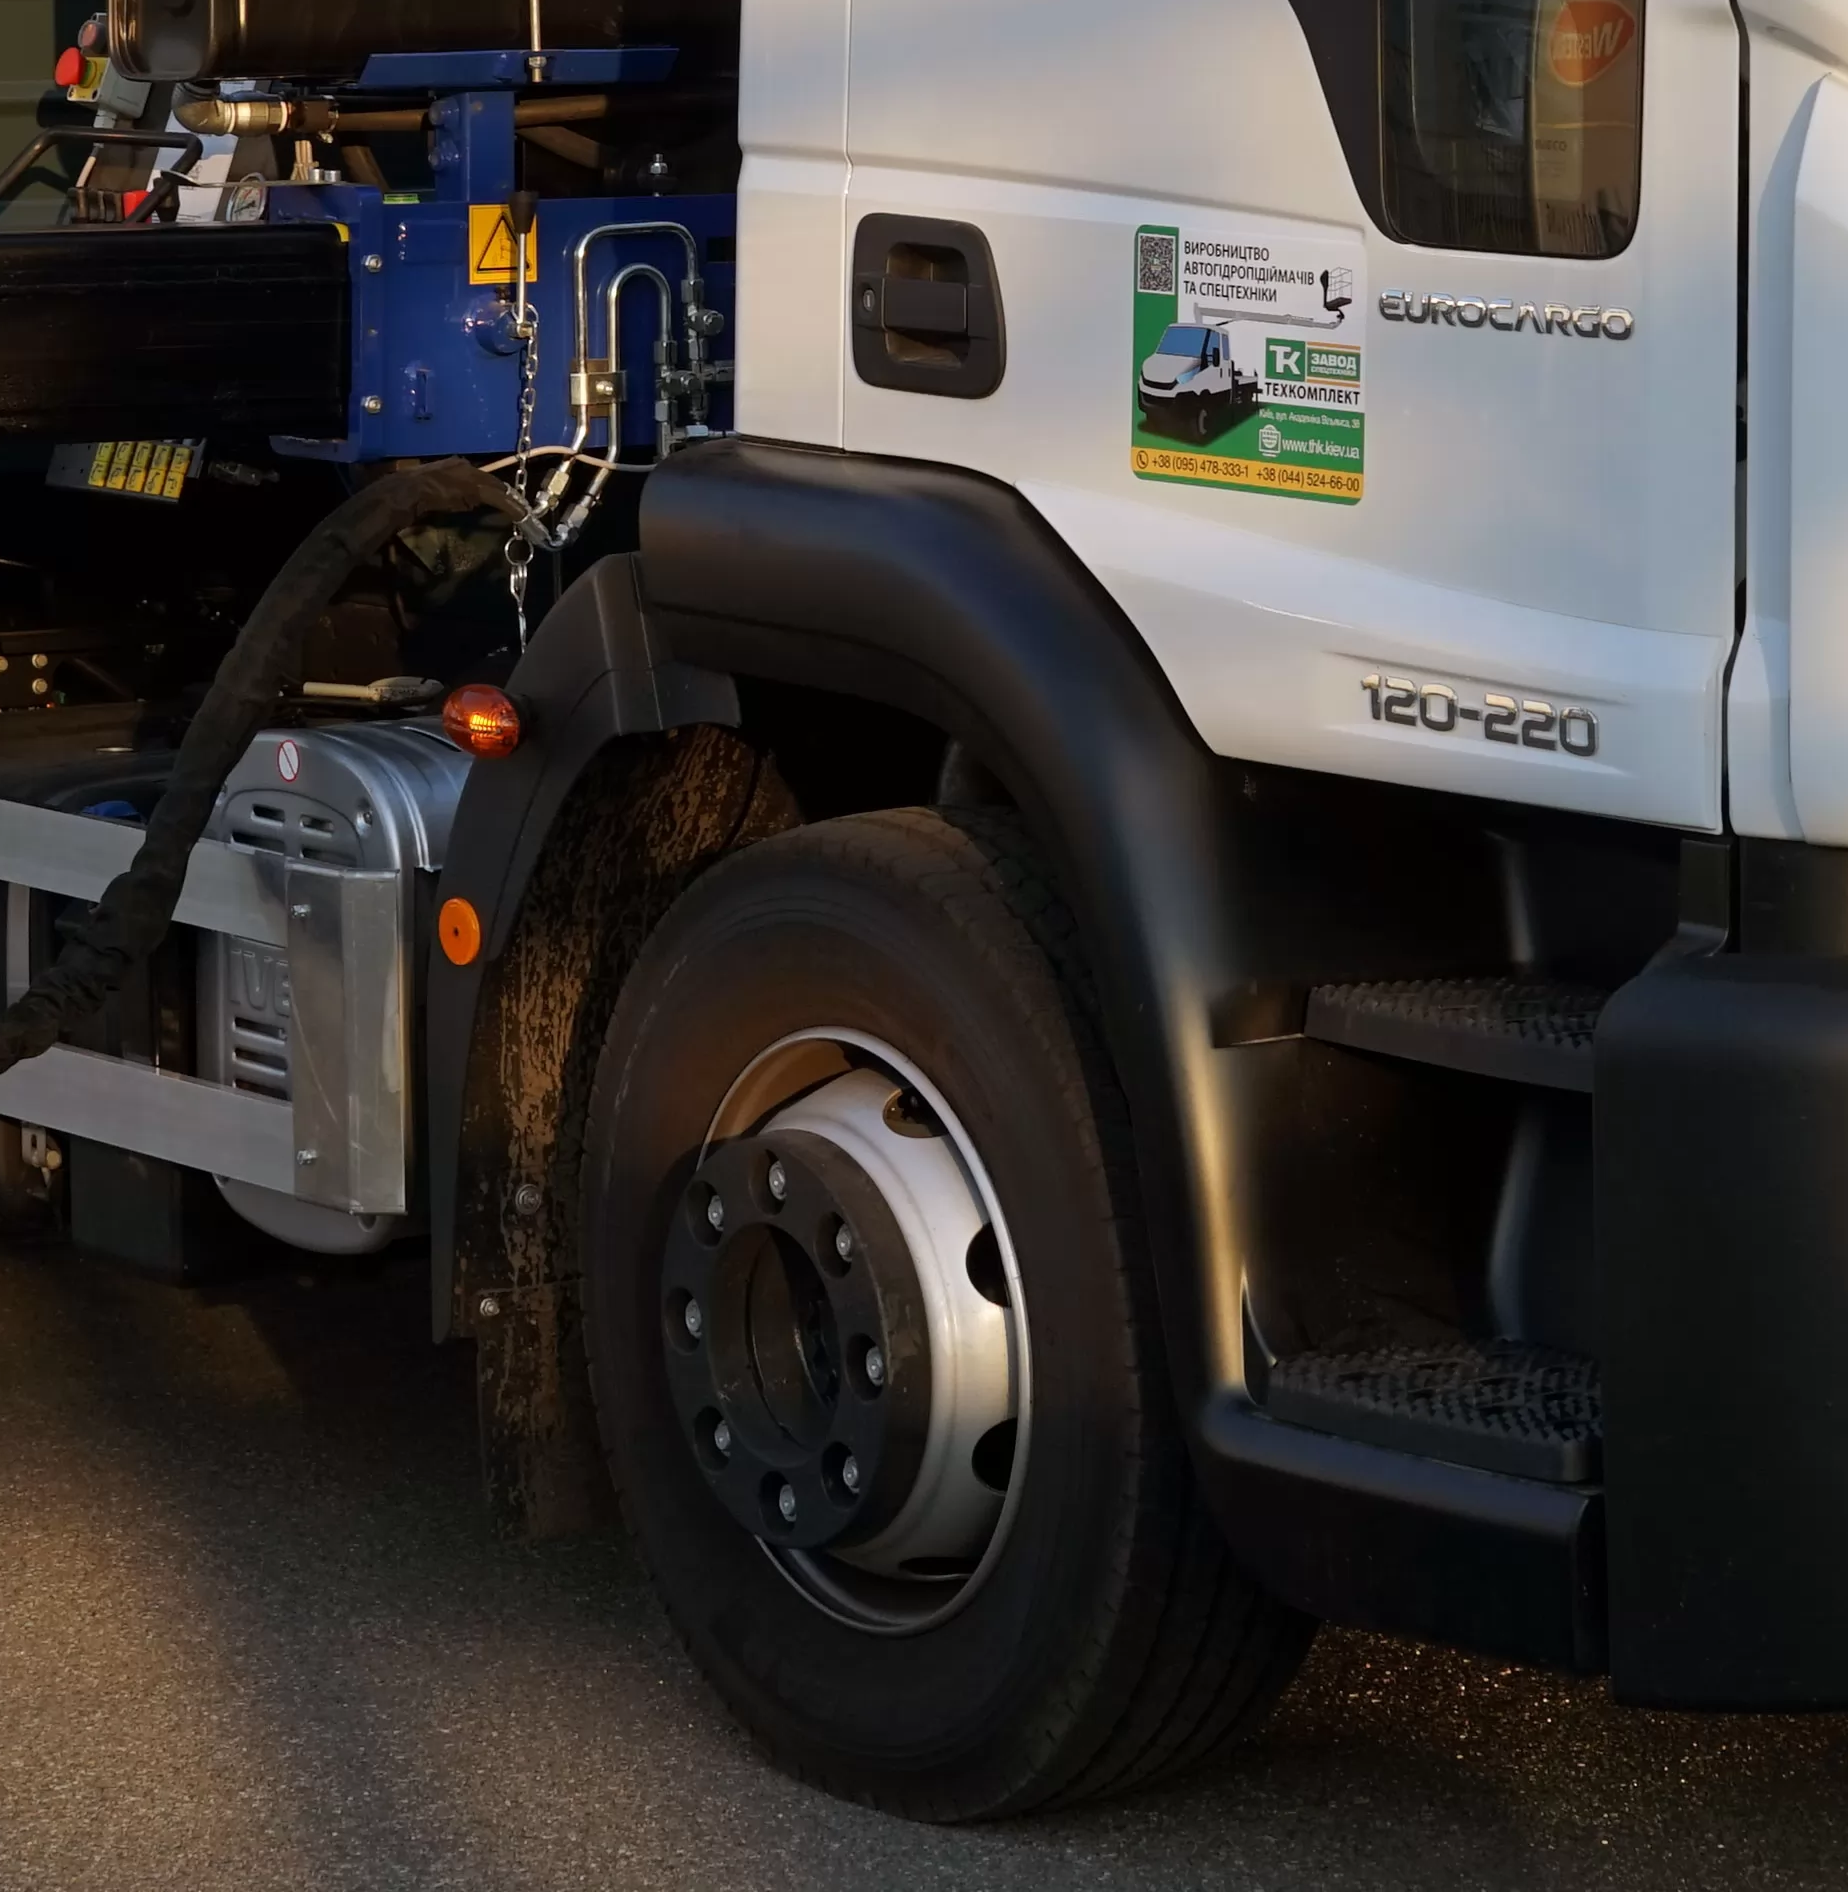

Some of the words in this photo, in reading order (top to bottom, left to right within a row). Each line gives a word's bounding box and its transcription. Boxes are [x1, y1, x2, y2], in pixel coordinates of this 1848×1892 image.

[1184, 241, 1270, 262] ВИРОБНИЦТВО
[1184, 261, 1315, 285] АВТОГІДРОПІДІЙМАЧІВ
[1184, 280, 1197, 295] ТА
[1199, 282, 1277, 303] СПЕЦТЕХНІКИ
[1378, 288, 1635, 341] EUROCARGO
[1310, 352, 1357, 370] ЗАВОД
[1265, 382, 1360, 405] ТЕХКОМПЛЕКТ
[1282, 438, 1360, 459] www.thk.kiev.ua
[1152, 454, 1170, 469] +38
[1172, 456, 1198, 475] (095)
[1200, 460, 1249, 478] 478-333-1
[1256, 468, 1275, 482] +38
[1278, 470, 1304, 488] (044)
[1306, 473, 1360, 492] 524-66-00
[1361, 672, 1600, 758] 120-220
